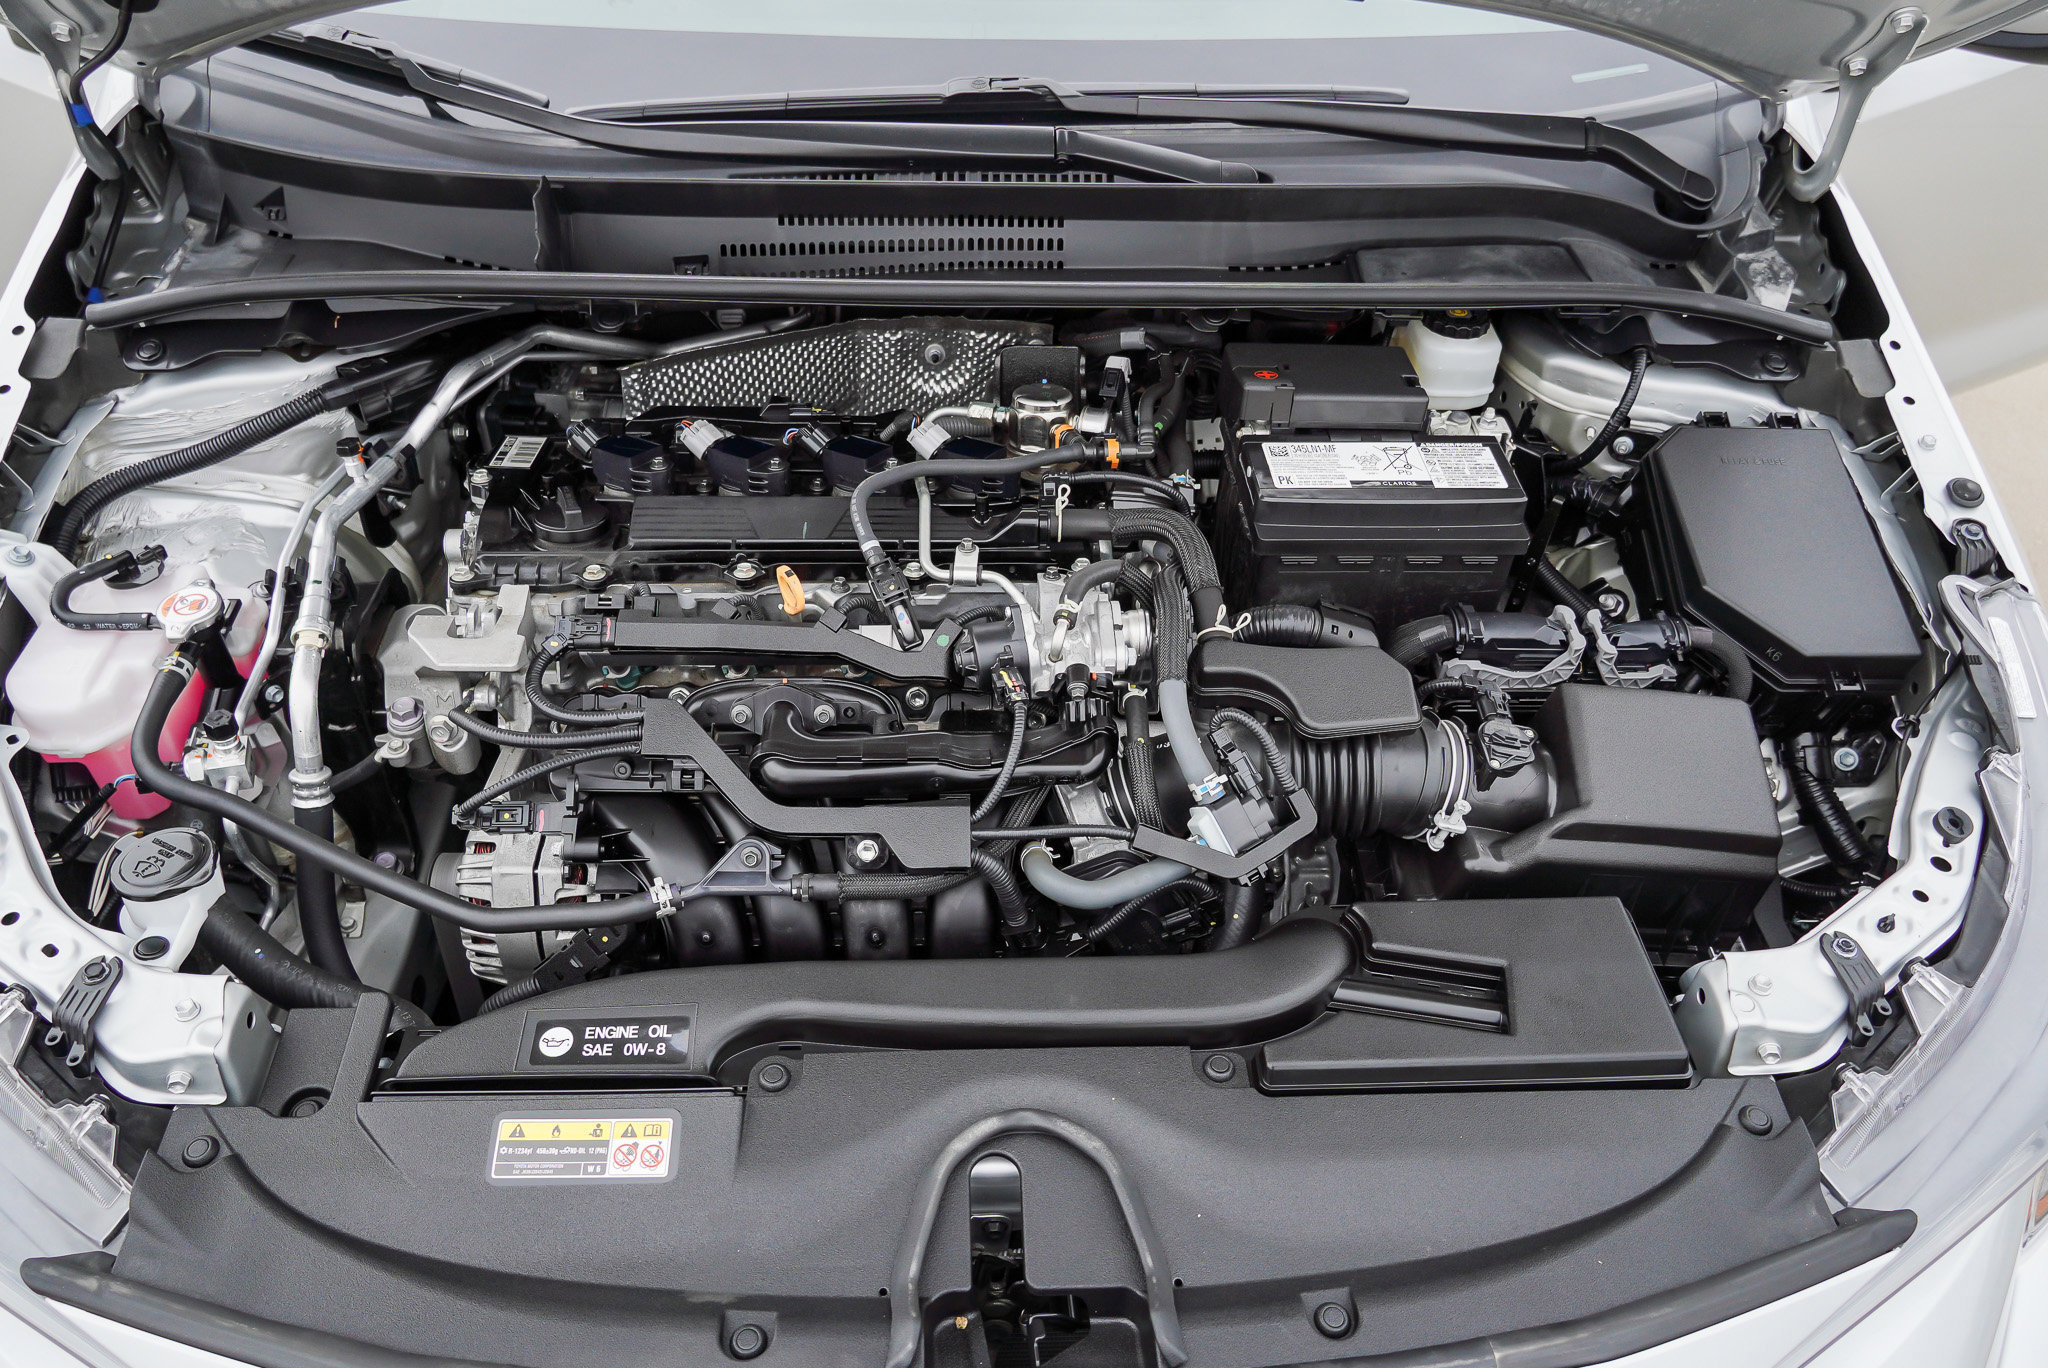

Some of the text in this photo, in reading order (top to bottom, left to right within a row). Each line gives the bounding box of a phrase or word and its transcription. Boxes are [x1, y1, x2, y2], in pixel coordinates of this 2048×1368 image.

[1278, 475, 1294, 485] PK
[584, 1024, 673, 1039] ENGINE OIL
[581, 1042, 667, 1056] SAE 0W-8
[587, 1165, 595, 1173] W
